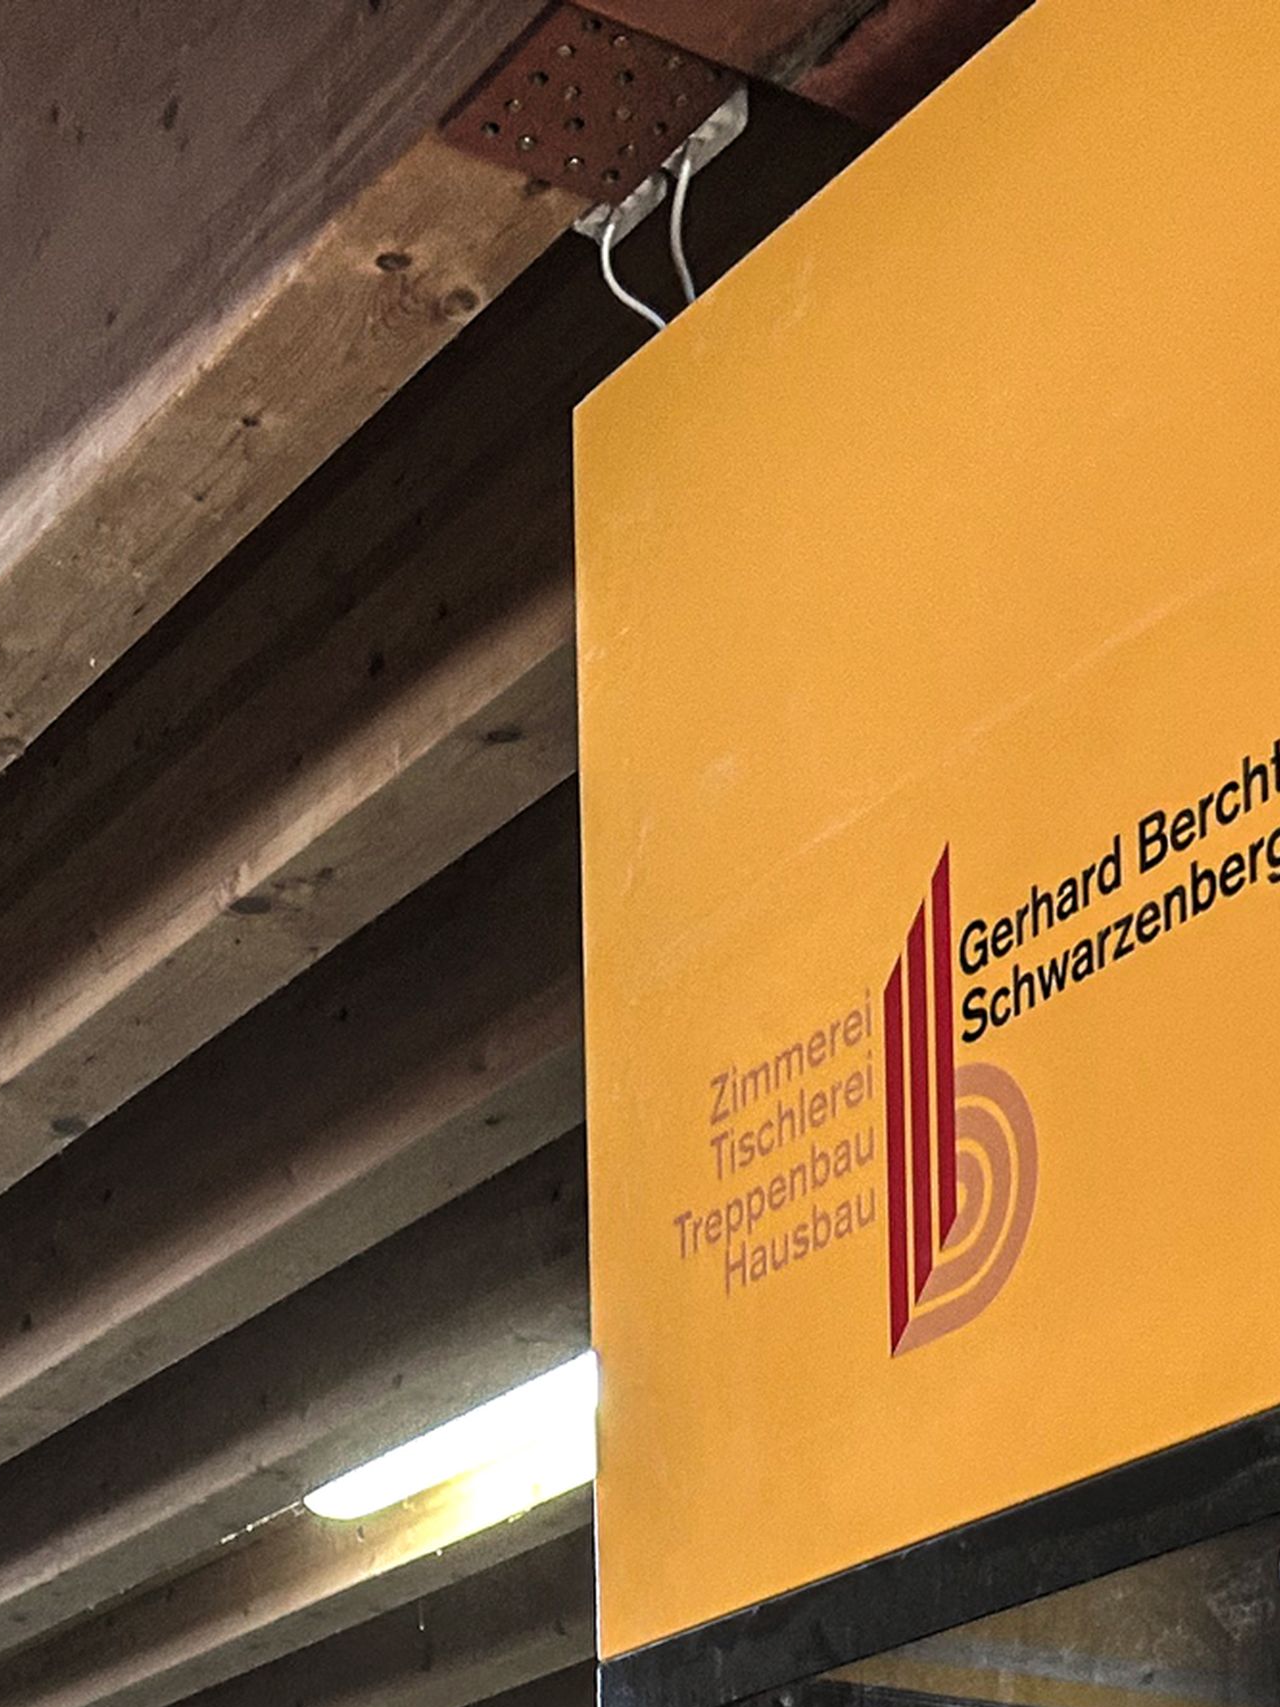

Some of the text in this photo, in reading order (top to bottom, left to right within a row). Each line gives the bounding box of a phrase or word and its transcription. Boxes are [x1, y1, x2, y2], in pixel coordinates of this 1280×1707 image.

[959, 836, 1121, 975] Gerhard
[709, 1051, 874, 1181] Tischlerei
[710, 989, 873, 1126] Zimmerei
[674, 1126, 876, 1260] Treppenbau
[724, 1189, 877, 1295] Hausbau
